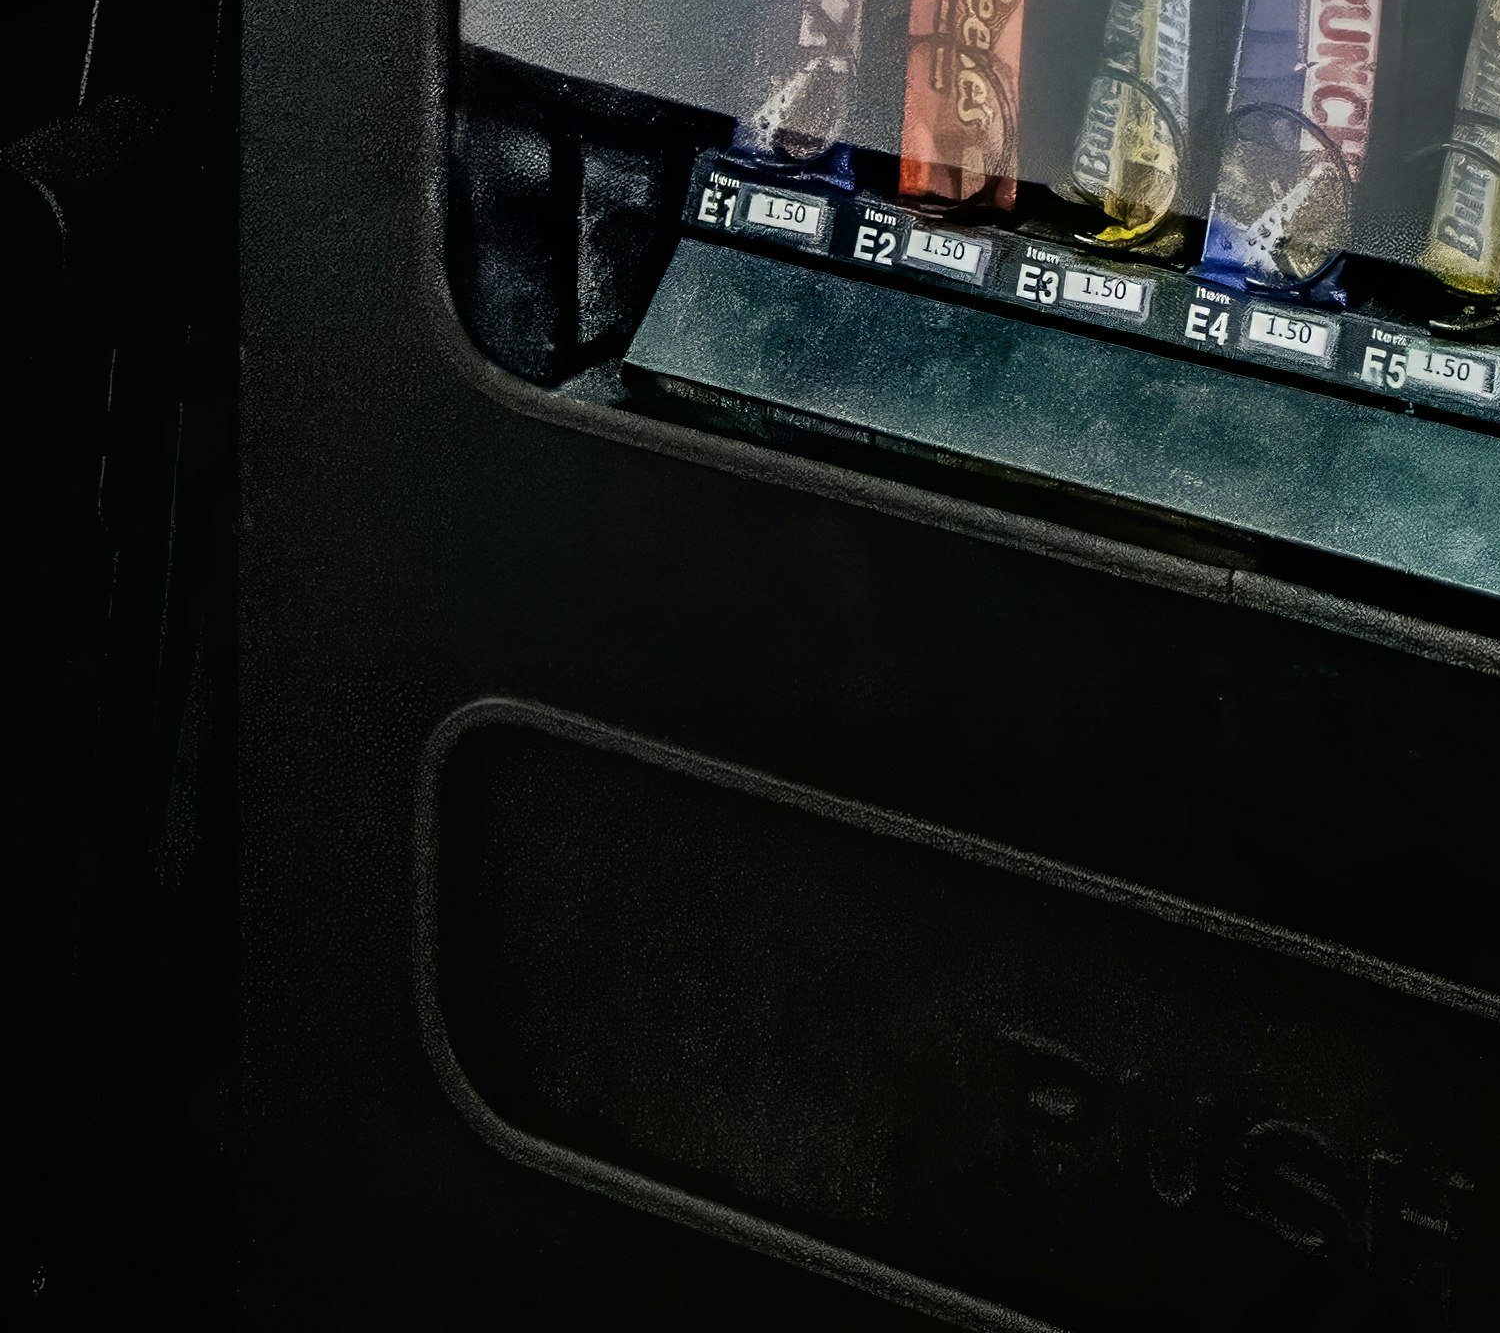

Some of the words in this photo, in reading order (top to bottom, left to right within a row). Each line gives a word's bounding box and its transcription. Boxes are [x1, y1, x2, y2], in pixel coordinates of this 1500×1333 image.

[763, 198, 807, 225] 1.50
[853, 225, 895, 266] E2
[921, 237, 966, 262] 1.50
[1016, 264, 1059, 305] E3
[1082, 275, 1128, 301] 1.50
[1184, 302, 1229, 345] E4
[1265, 317, 1314, 344] 1.50
[1420, 355, 1472, 383] 1.50
